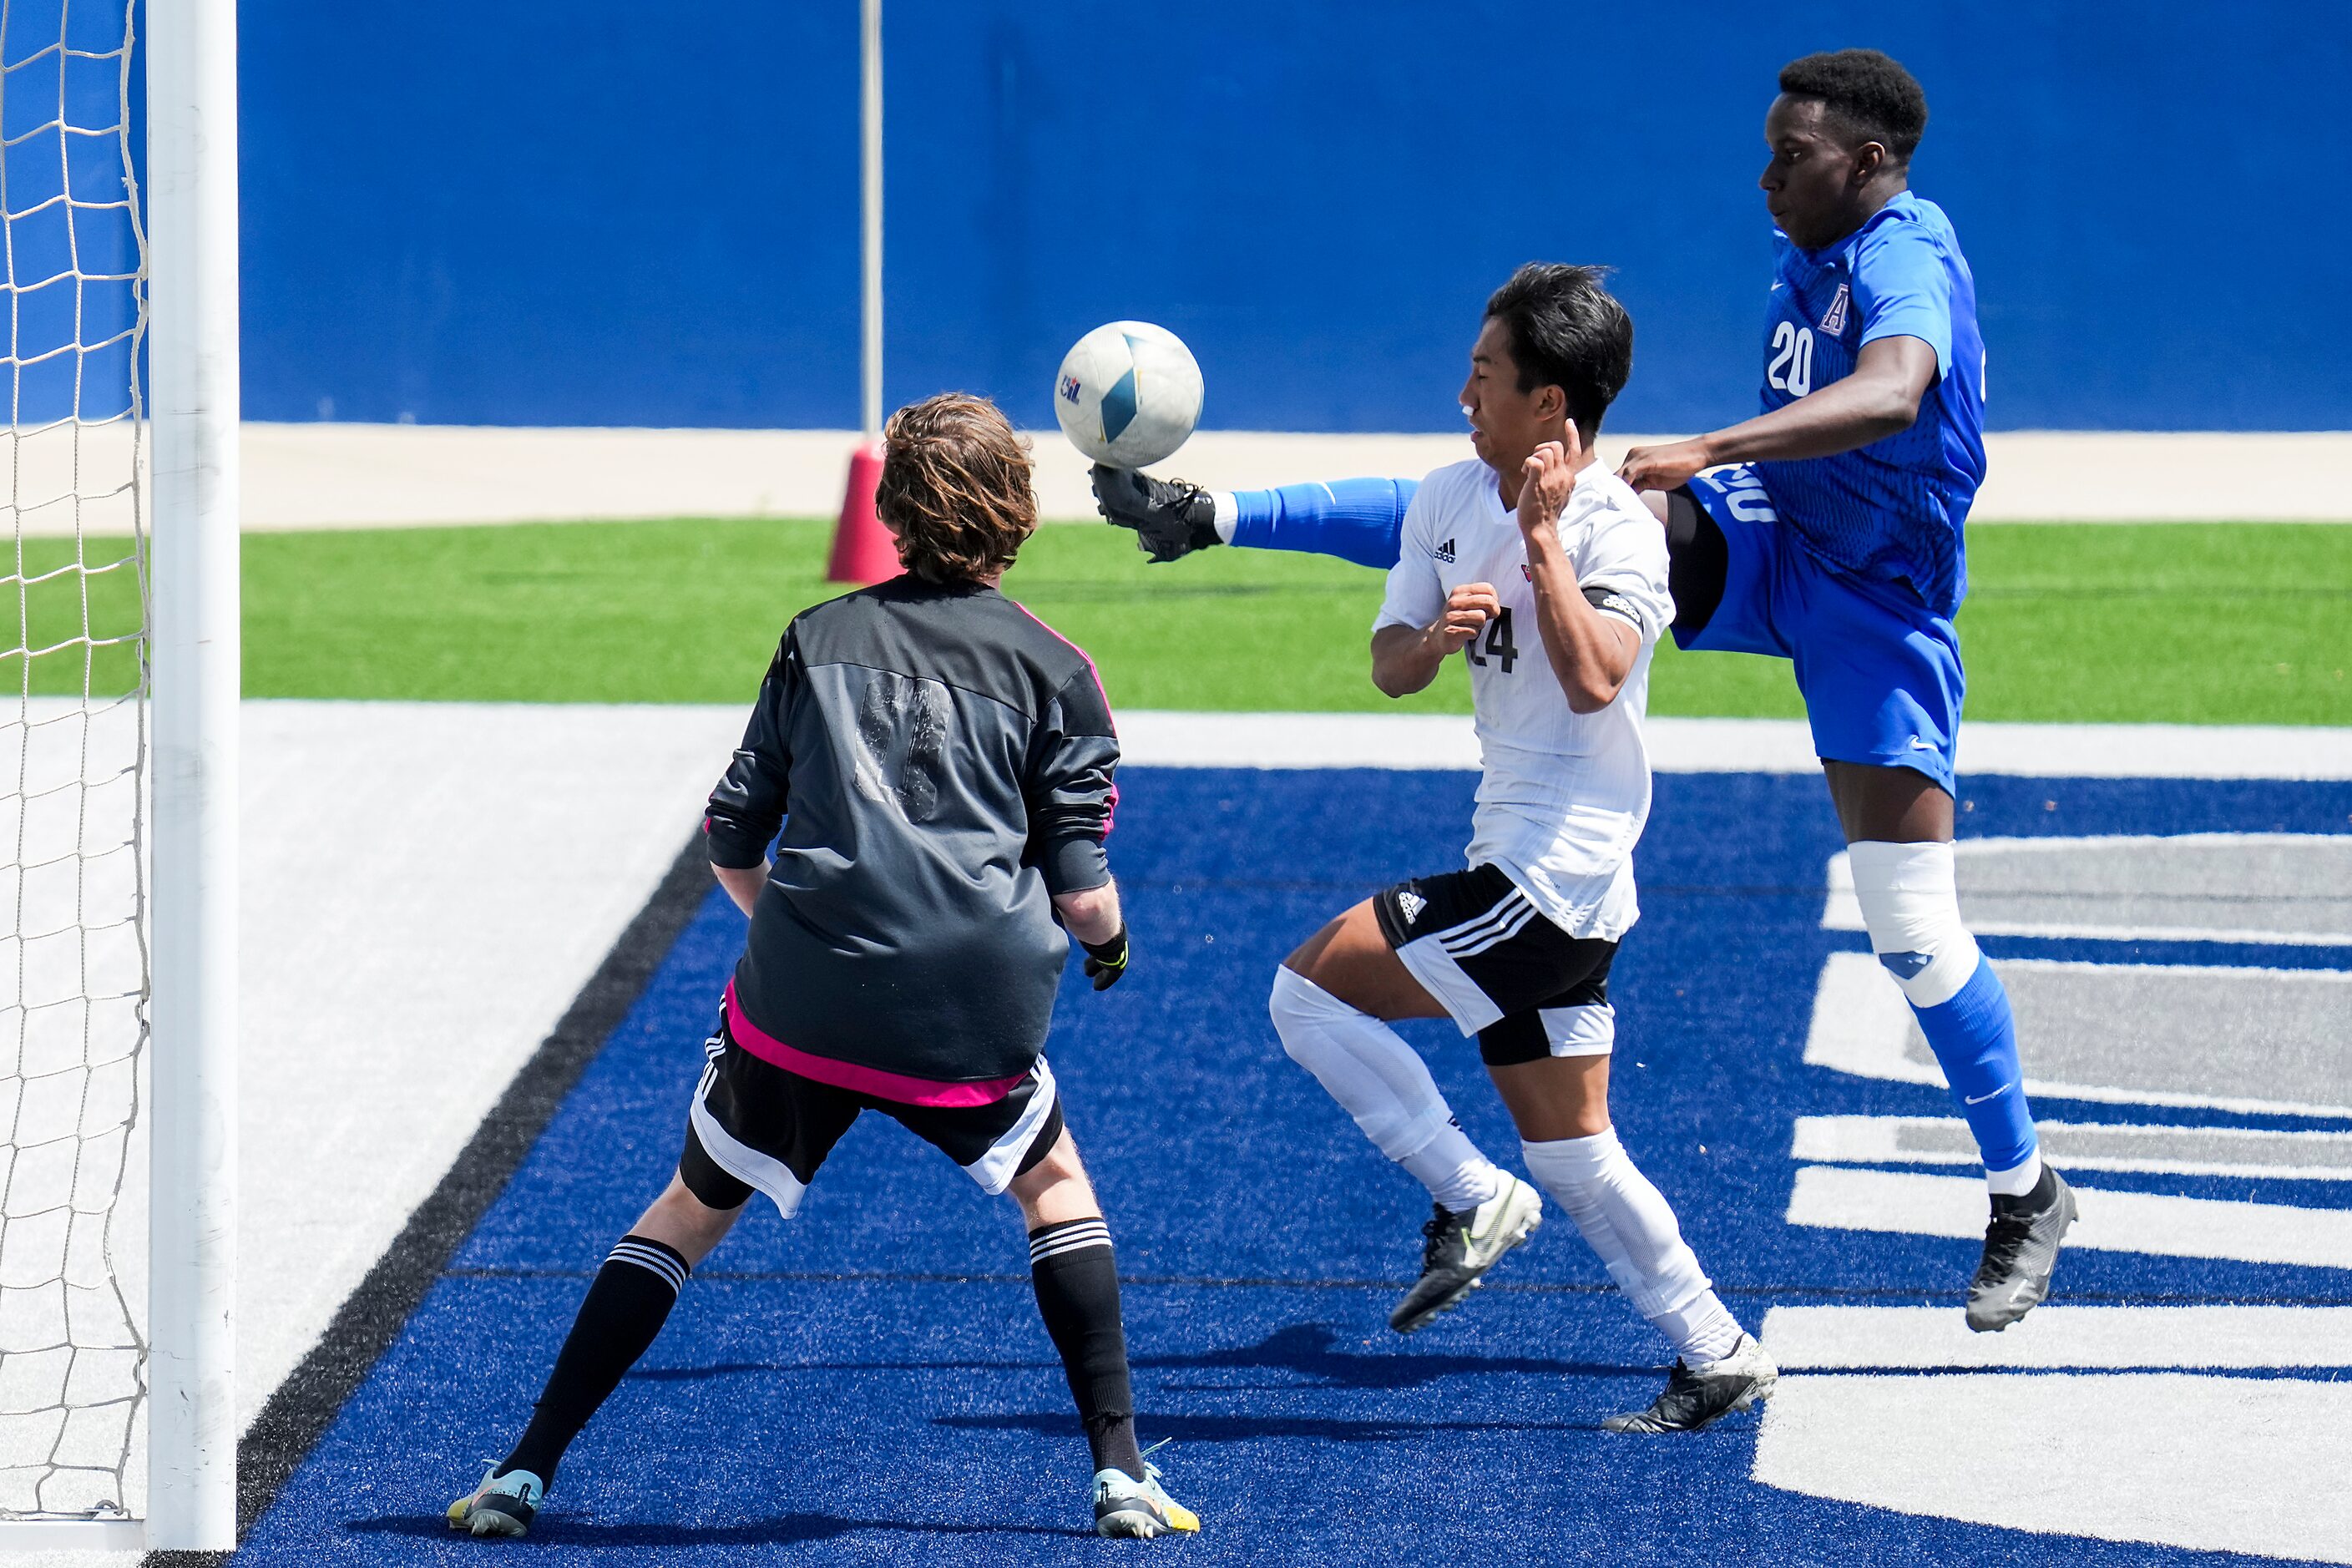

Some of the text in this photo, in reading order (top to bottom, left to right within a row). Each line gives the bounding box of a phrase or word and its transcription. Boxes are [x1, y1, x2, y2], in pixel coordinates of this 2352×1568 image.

[1768, 321, 1813, 397] 20
[1434, 551, 1455, 564] adidas
[1603, 596, 1641, 623] adidas
[1399, 892, 1416, 925] adidas
